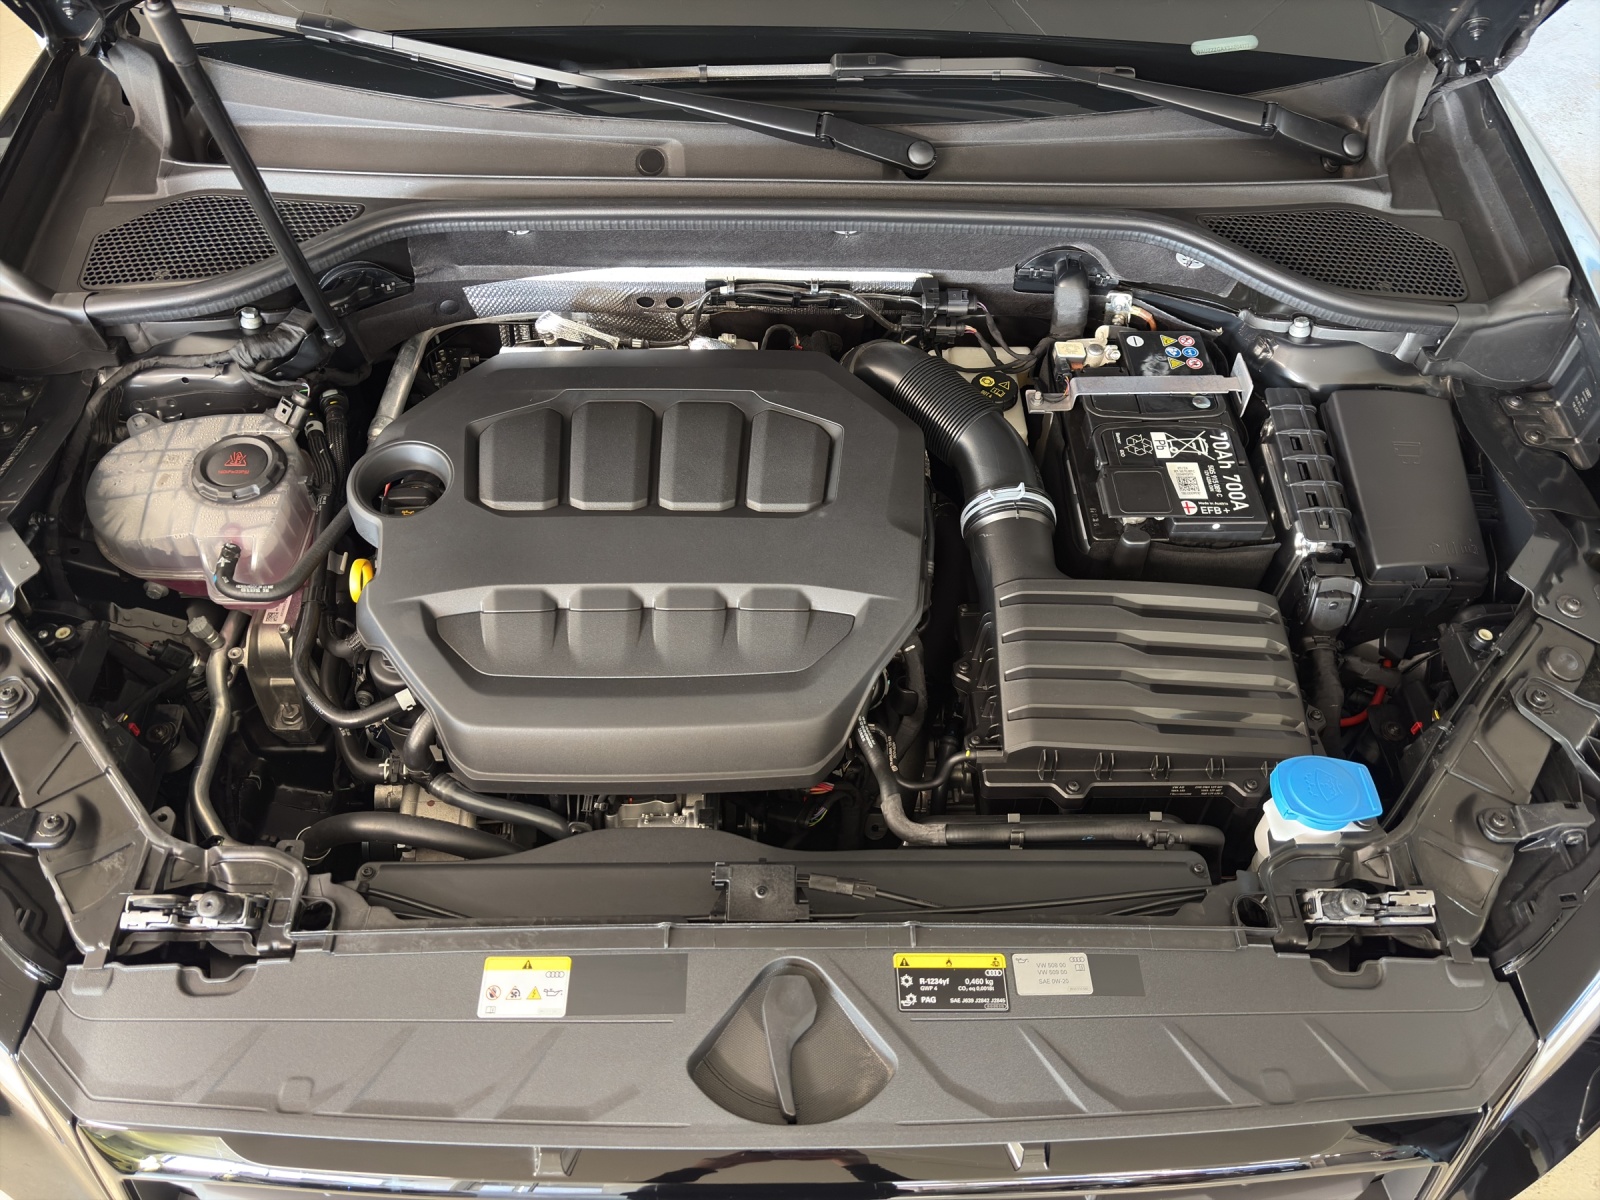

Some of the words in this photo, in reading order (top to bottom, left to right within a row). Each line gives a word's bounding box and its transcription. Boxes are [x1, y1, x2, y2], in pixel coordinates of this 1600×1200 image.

[1154, 439, 1166, 450] Pb
[1209, 431, 1236, 469] 70Ah
[1222, 474, 1250, 511] 700A
[920, 978, 950, 986] R-1234yf
[985, 978, 994, 986] kg
